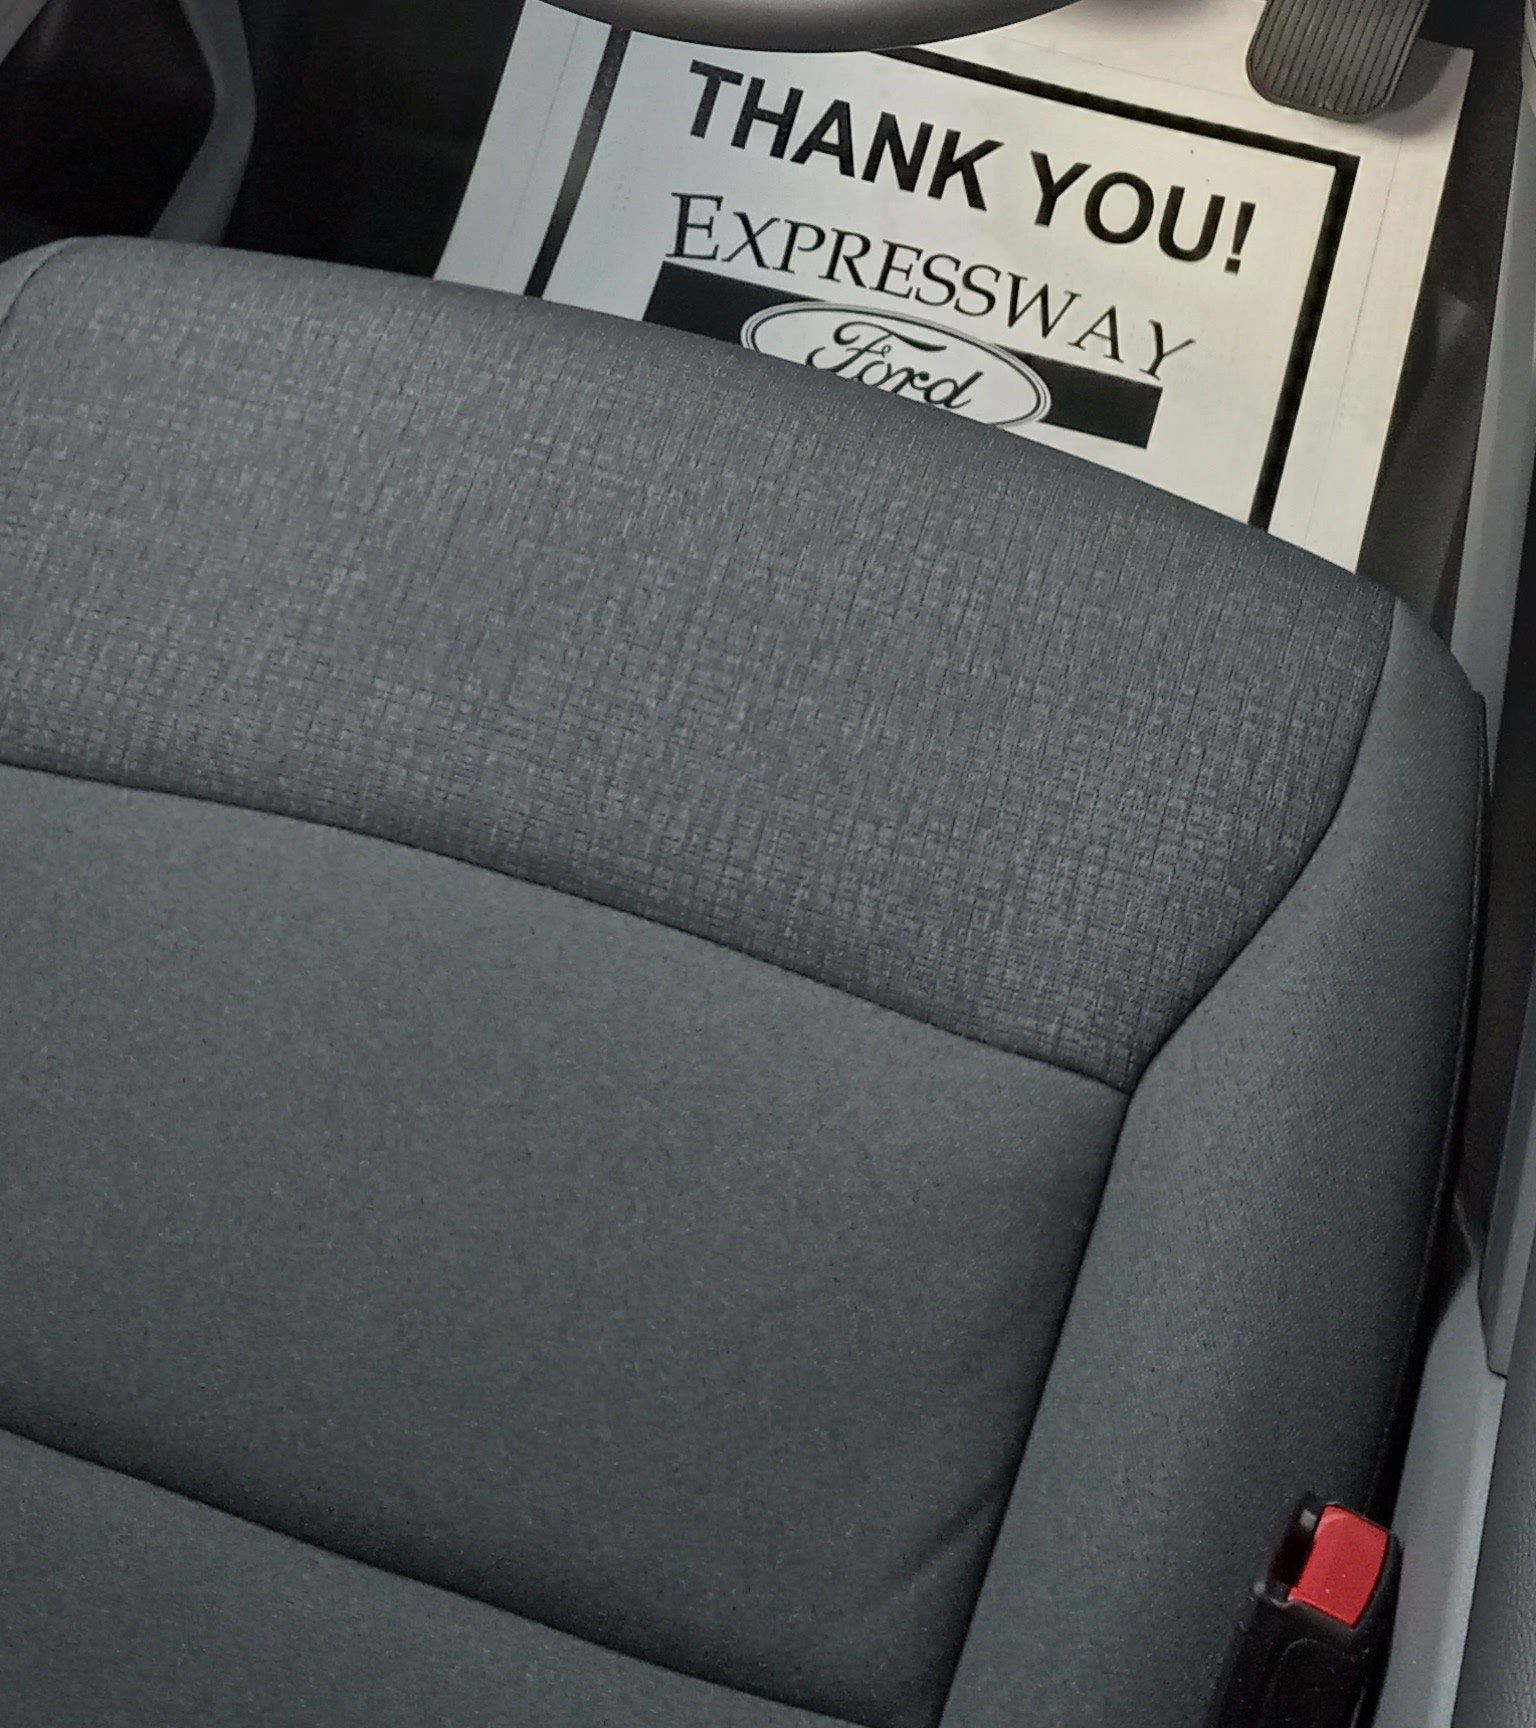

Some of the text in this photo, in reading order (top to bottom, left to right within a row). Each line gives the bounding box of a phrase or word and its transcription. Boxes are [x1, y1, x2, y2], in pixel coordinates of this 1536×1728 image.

[689, 59, 1257, 275] THANK YOU!
[806, 320, 985, 413] Ford
